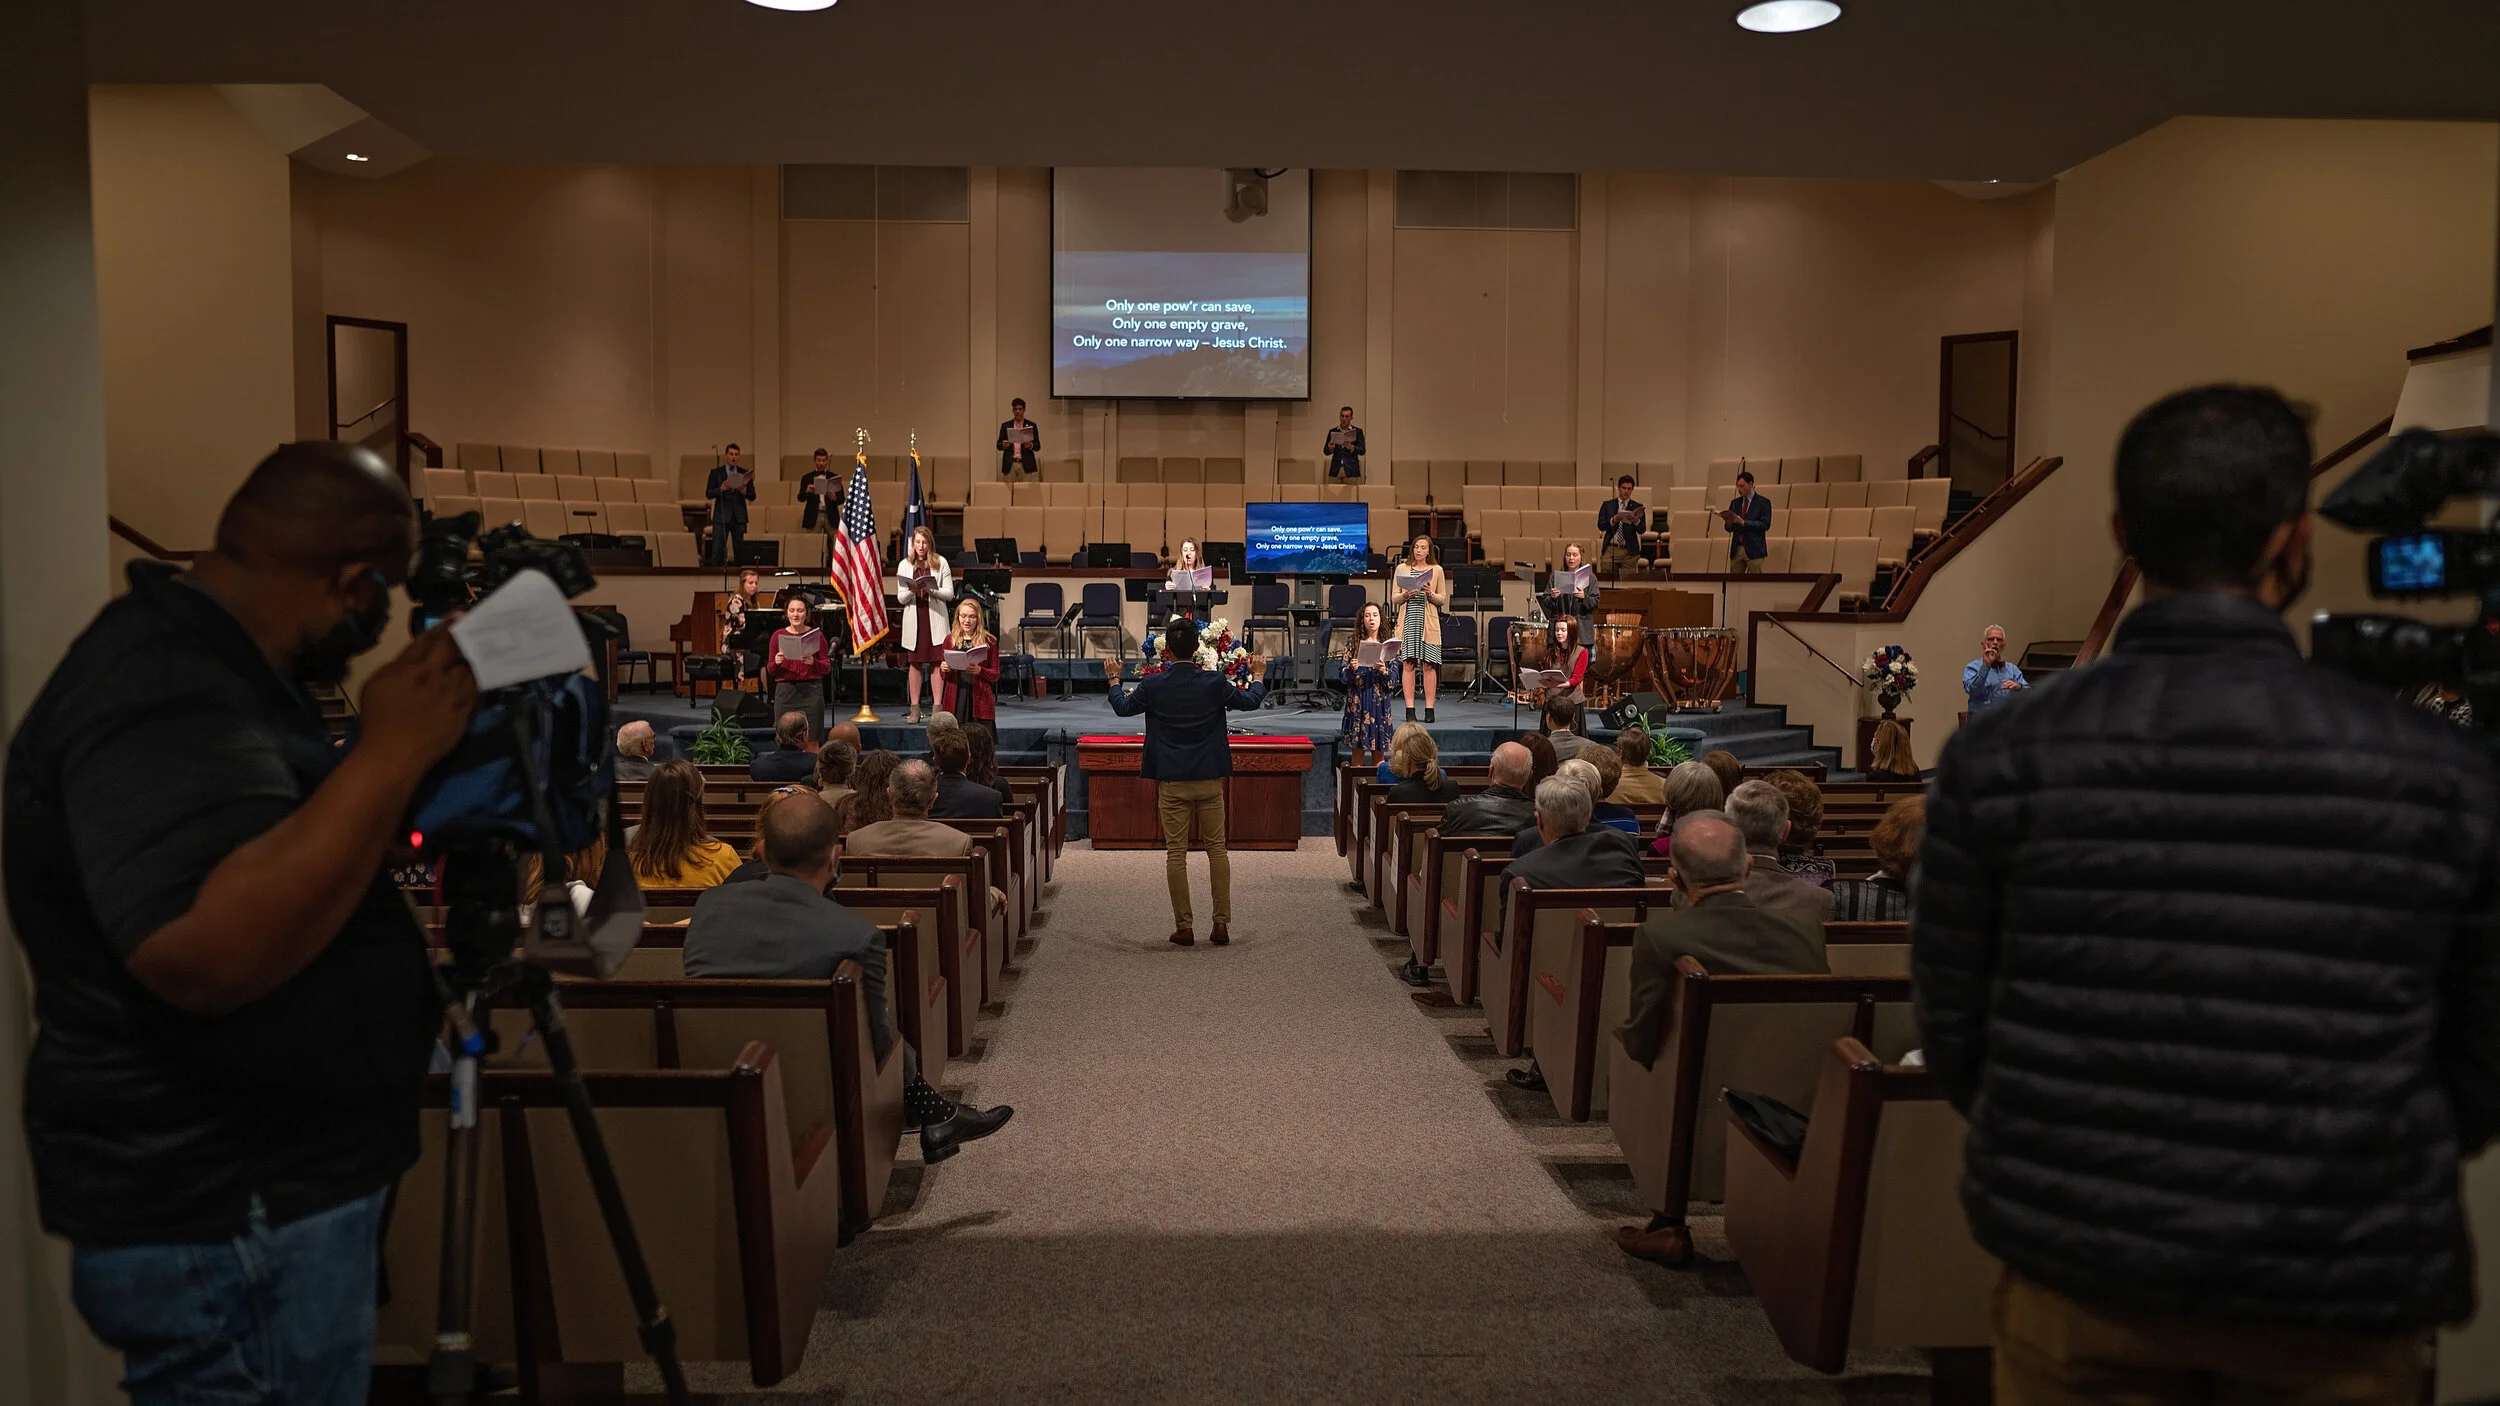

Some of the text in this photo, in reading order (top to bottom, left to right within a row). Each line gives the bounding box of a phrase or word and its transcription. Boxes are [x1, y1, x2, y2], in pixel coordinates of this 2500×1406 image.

[1105, 299, 1134, 314] Only
[1137, 302, 1160, 311] one
[1201, 303, 1221, 312] can
[1225, 304, 1255, 314] save,
[1112, 317, 1249, 333] Only one empty grave,
[1073, 335, 1102, 349] Only
[1105, 338, 1128, 347] one
[1131, 338, 1173, 347] narrow
[1175, 339, 1199, 350] way
[1212, 338, 1245, 348] Jesus
[1249, 337, 1287, 349] Christ.
[1270, 526, 1286, 534] Only
[1273, 534, 1288, 542] Only
[1255, 543, 1270, 551] Only
